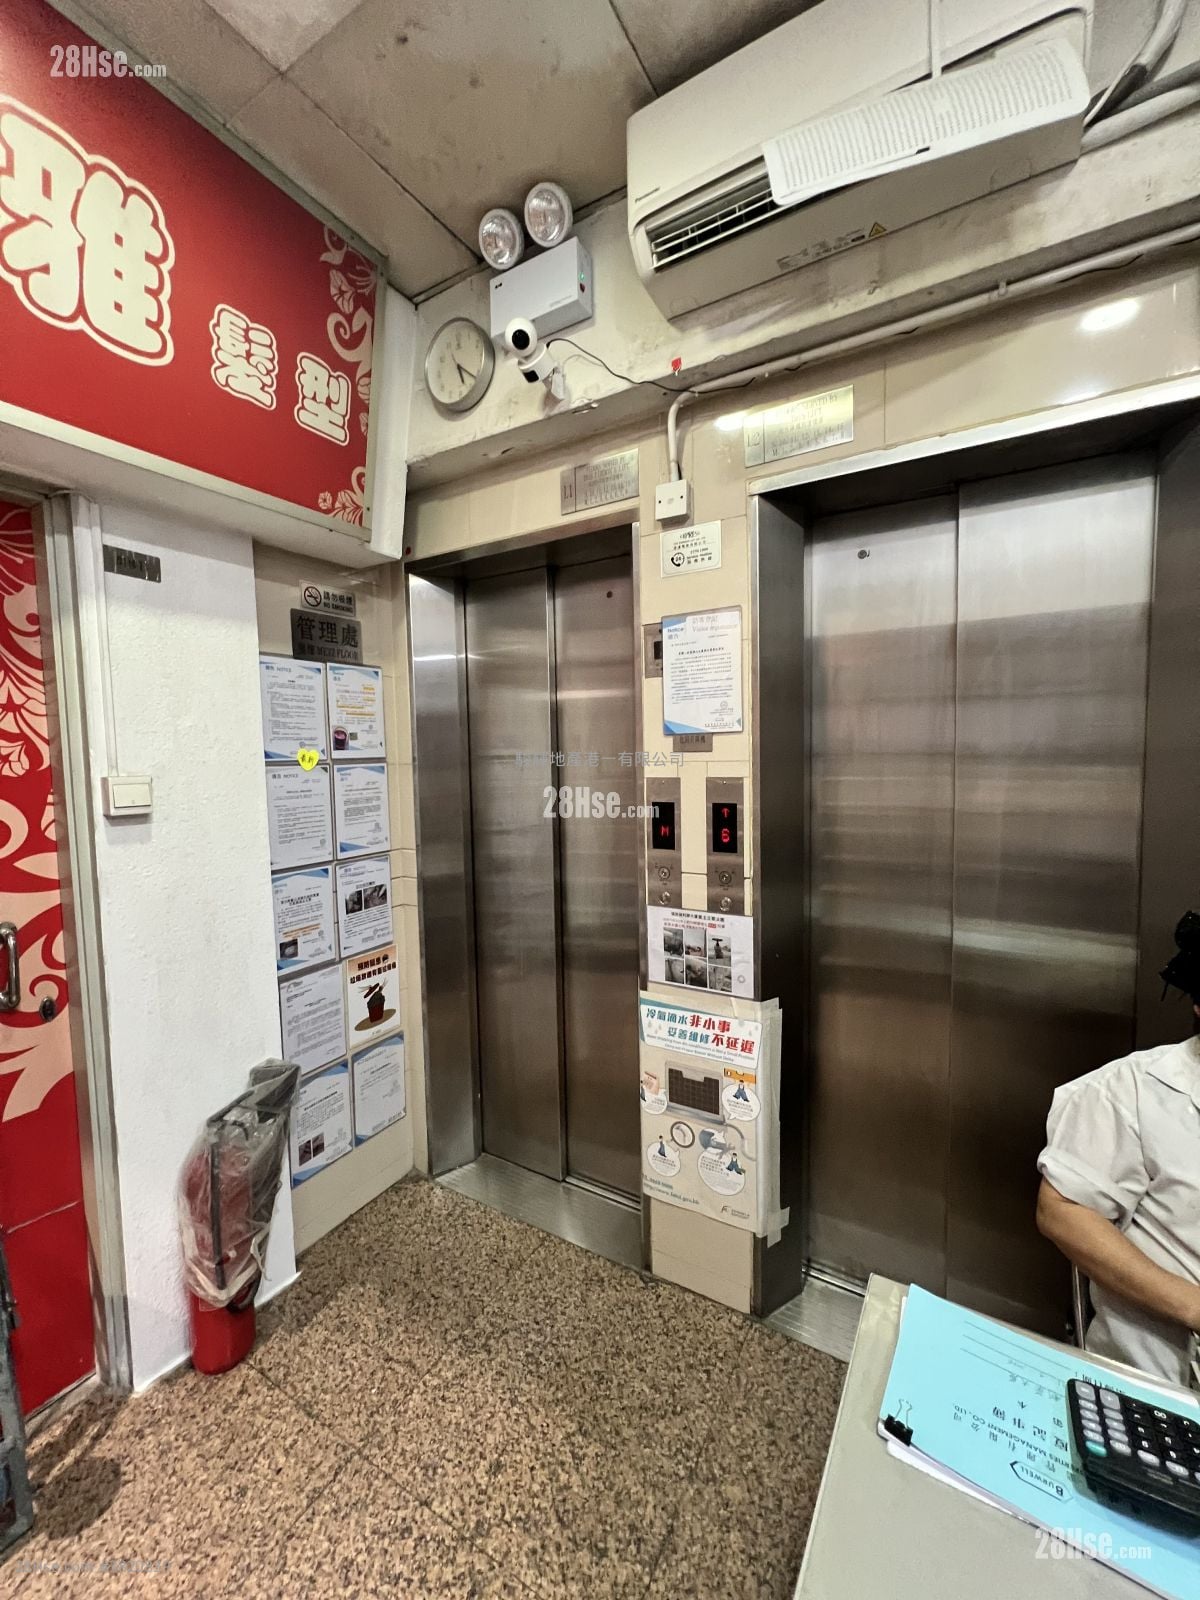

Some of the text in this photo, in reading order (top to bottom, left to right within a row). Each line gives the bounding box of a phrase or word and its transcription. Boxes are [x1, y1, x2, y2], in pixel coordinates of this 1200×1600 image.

[296, 615, 358, 648] 管理處
[661, 825, 670, 837] M
[721, 828, 730, 843] 6
[646, 1008, 731, 1033] 冷氣滴水非小事
[668, 1027, 755, 1055] 妥善維修不延遲
